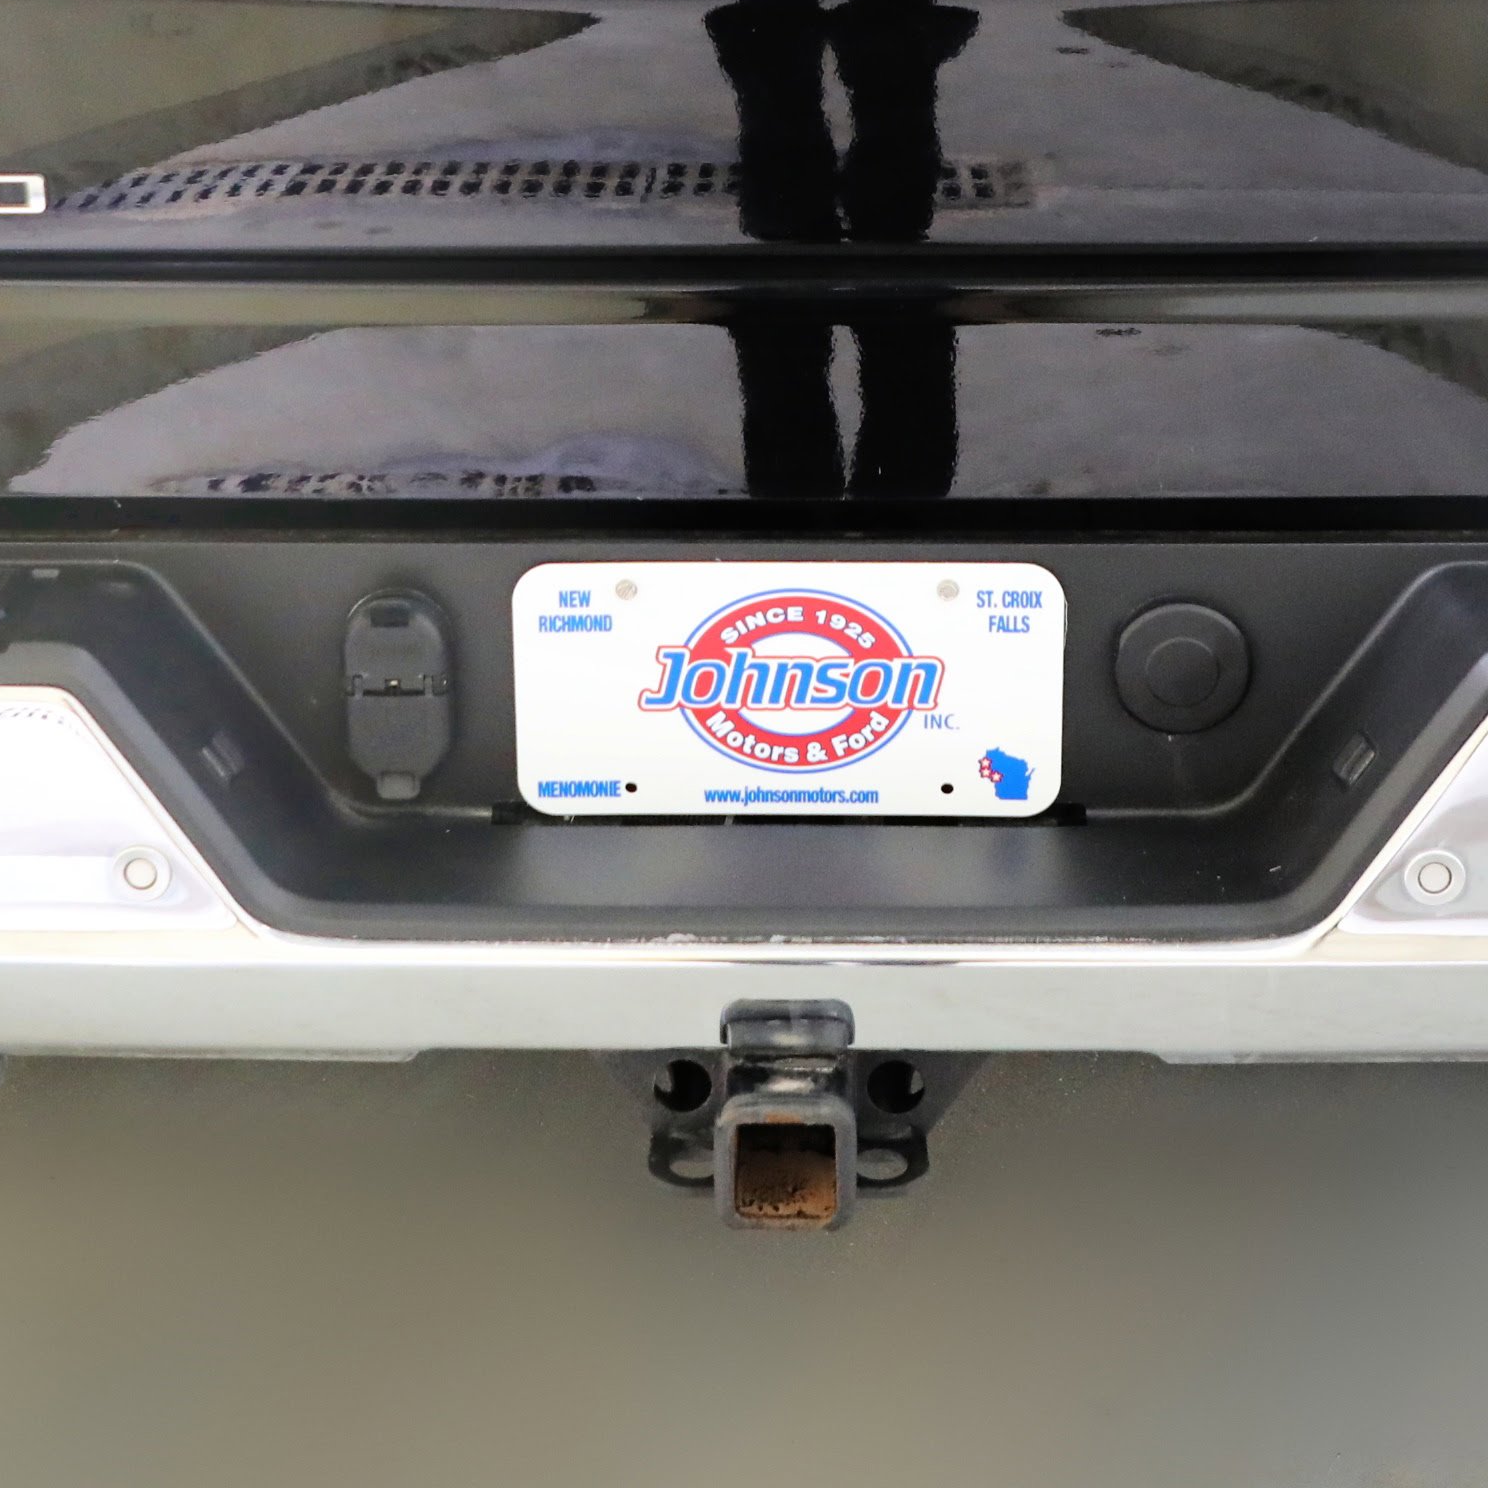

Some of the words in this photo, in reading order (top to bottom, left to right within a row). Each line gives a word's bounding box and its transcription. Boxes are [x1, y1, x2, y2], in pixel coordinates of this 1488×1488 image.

[558, 590, 591, 608] NEW
[976, 590, 998, 608] ST.
[1001, 590, 1043, 609] CROIX
[538, 615, 613, 633] RICHMOND
[720, 606, 805, 646] SINCE
[815, 607, 876, 650] 1925
[988, 615, 1030, 633] FALLS
[644, 647, 939, 706] Johnson
[923, 714, 960, 731] INC.
[705, 711, 799, 764] Motors
[806, 741, 828, 763] &
[832, 712, 890, 757] Ford
[537, 780, 621, 798] MENOMONIE
[704, 786, 879, 806] www.johnsonmotors.com
